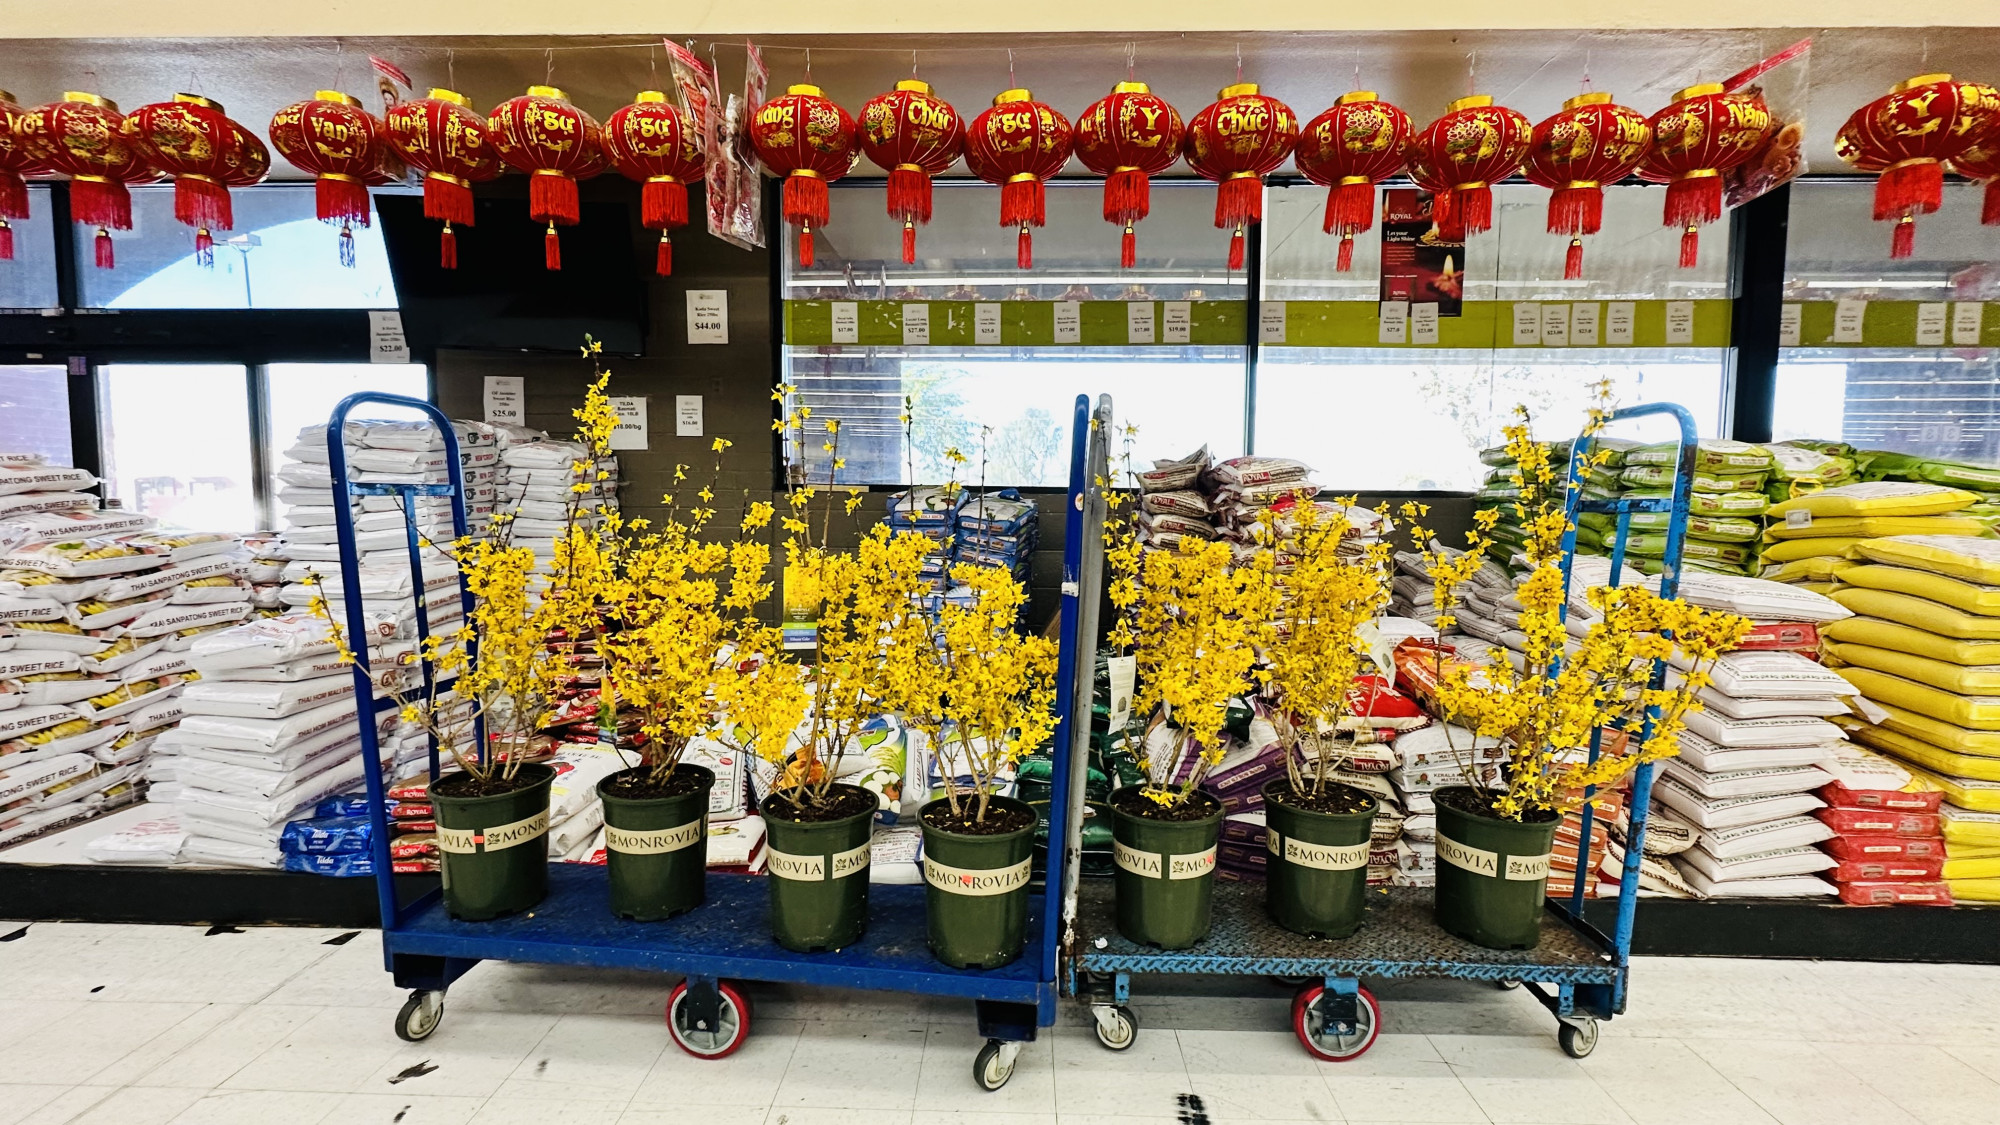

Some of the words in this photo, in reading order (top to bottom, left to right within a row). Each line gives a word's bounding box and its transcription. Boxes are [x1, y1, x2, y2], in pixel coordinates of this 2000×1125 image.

[543, 111, 576, 136] Sự
[1001, 111, 1032, 134] Sự
[1140, 104, 1163, 130] Ý
[1217, 106, 1269, 136] Chúc
[310, 115, 349, 143] Vạn
[640, 116, 671, 140] Sự
[1390, 212, 1413, 221] ROYAL
[695, 322, 721, 330] $44.00
[492, 409, 517, 417] $25.00
[34, 474, 61, 483] SWEET
[62, 473, 82, 481] RICE
[71, 499, 89, 507] RICE
[37, 529, 58, 538] THAI
[58, 524, 103, 535] SANPATONG
[104, 520, 129, 530] SWEET
[129, 518, 145, 527] RICE
[131, 583, 148, 592] THAI
[148, 571, 191, 587] SANPATONG
[191, 565, 214, 576] SWEET
[214, 562, 230, 570] RICE
[31, 607, 52, 616] RICE
[166, 612, 207, 626] SANPATONG
[207, 610, 230, 619] SWEET
[230, 606, 243, 614] RICE
[9, 663, 43, 673] SWEET
[44, 661, 65, 670] RICE
[149, 666, 166, 675] THAI
[328, 662, 343, 670] HOM
[313, 692, 327, 701] HOM
[328, 688, 341, 697] MALI
[17, 715, 47, 729] SWEET
[50, 712, 68, 722] RICE
[149, 712, 166, 723] THAI
[298, 730, 312, 738] THAI
[313, 723, 327, 732] HOM
[26, 773, 56, 790] SWEET
[58, 765, 78, 777] RICE
[404, 790, 427, 798] ROYAL
[38, 817, 67, 836] SWEET
[311, 830, 329, 839] Tilda
[617, 826, 700, 850] MONROVIA
[316, 855, 334, 865] Tilda
